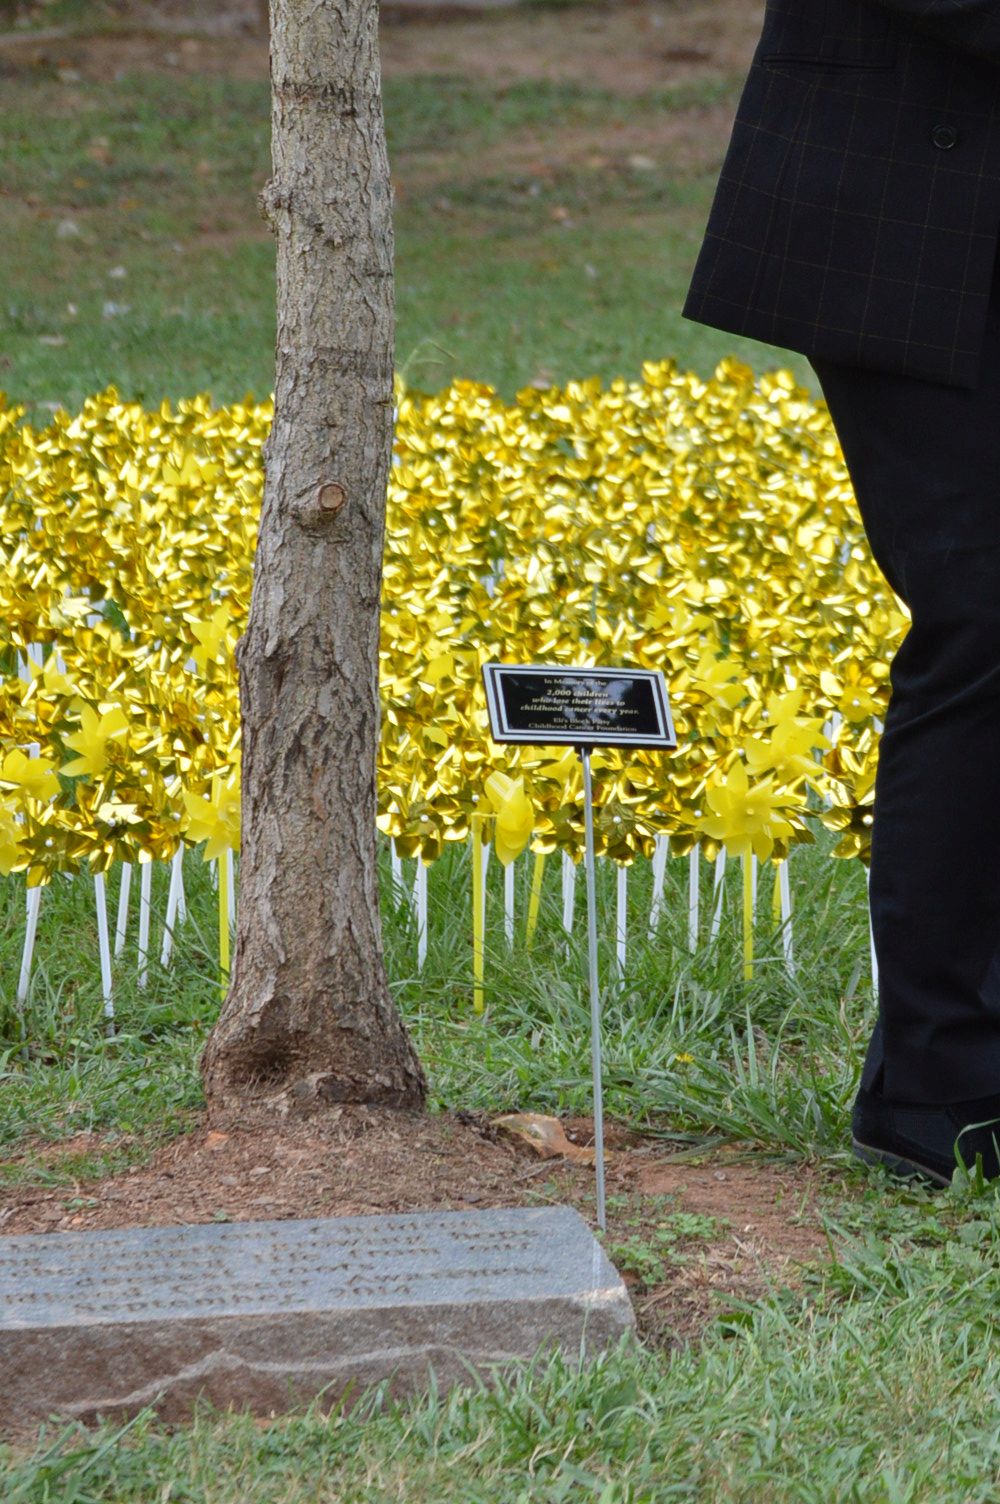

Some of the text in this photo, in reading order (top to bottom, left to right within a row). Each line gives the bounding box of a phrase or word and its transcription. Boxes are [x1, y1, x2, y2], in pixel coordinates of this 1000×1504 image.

[573, 690, 608, 698] children
[520, 704, 562, 712] childhood
[564, 705, 592, 713] cancer
[594, 706, 617, 715] every
